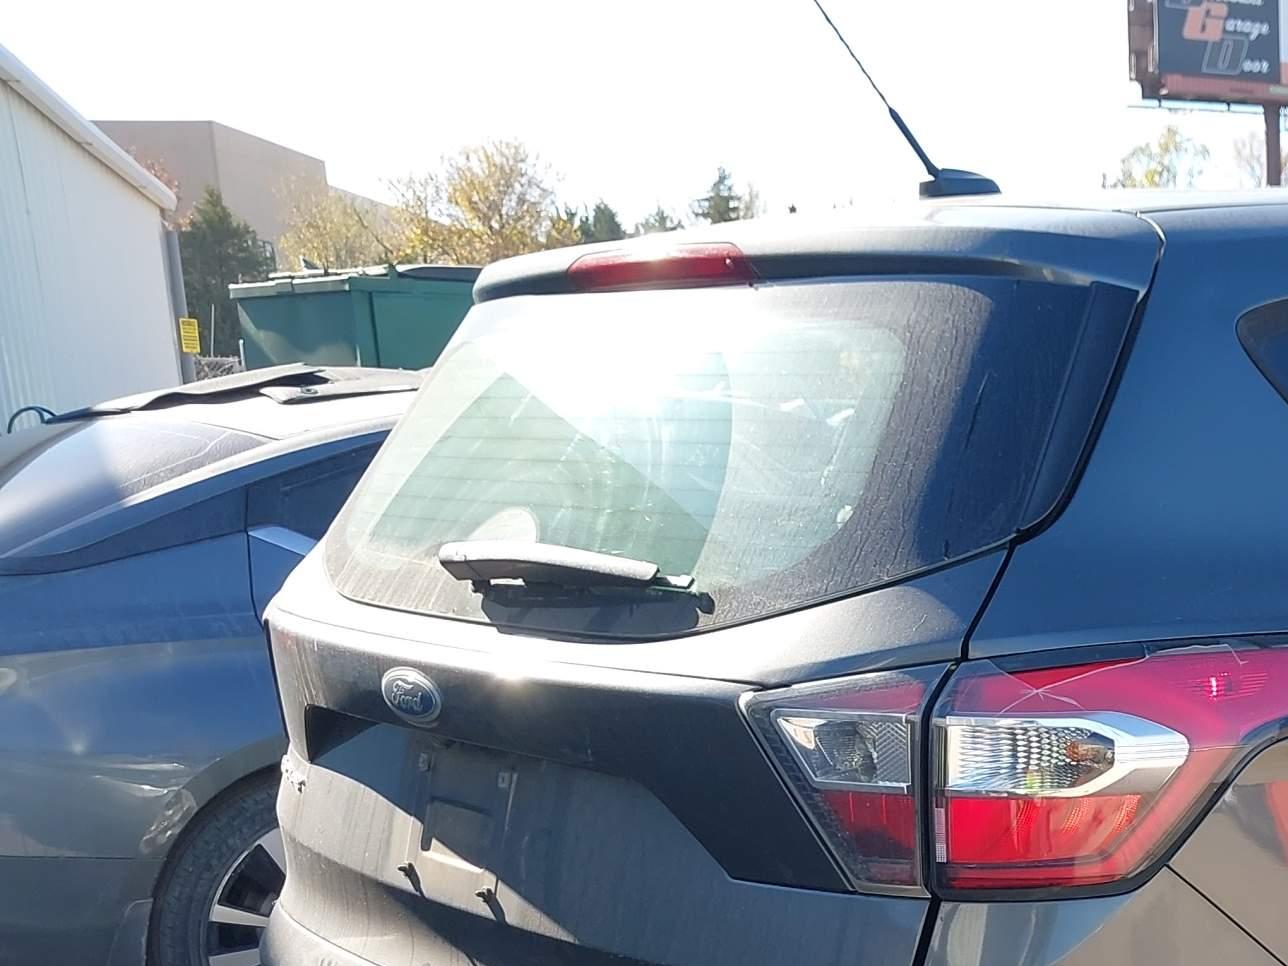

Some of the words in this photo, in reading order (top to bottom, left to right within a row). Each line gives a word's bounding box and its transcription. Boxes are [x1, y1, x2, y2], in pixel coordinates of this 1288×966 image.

[1183, 2, 1271, 42] Garage
[1201, 33, 1271, 76] Door
[391, 679, 423, 712] Ford
